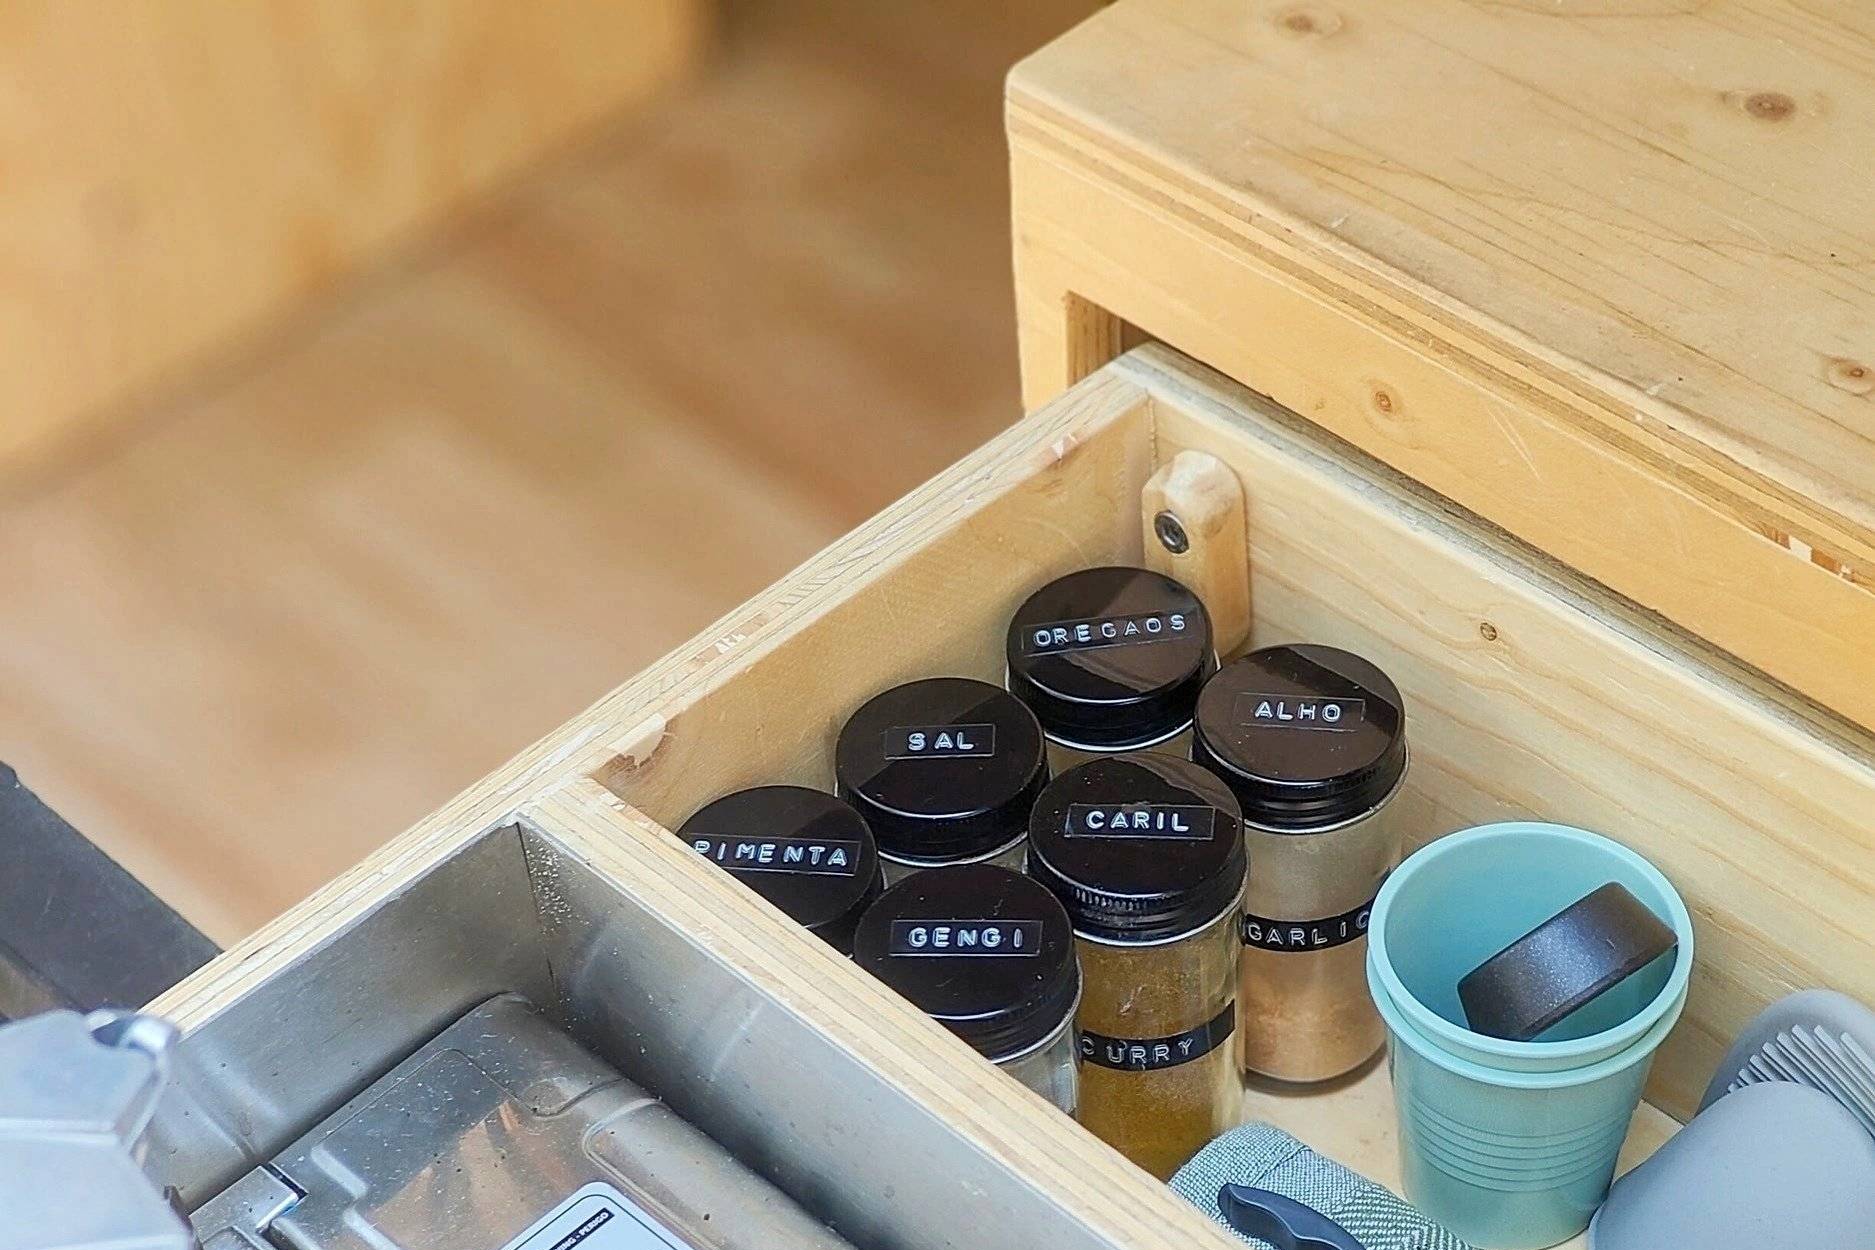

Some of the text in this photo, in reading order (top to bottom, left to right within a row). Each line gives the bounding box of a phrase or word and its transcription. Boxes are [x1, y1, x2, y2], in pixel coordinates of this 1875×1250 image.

[1033, 613, 1187, 648] OREGAOS
[1253, 700, 1342, 723] ALHO
[907, 731, 975, 752] SAL
[1085, 810, 1190, 832] CARIL
[694, 840, 848, 867] PIMENTA
[908, 926, 1023, 949] GENGI
